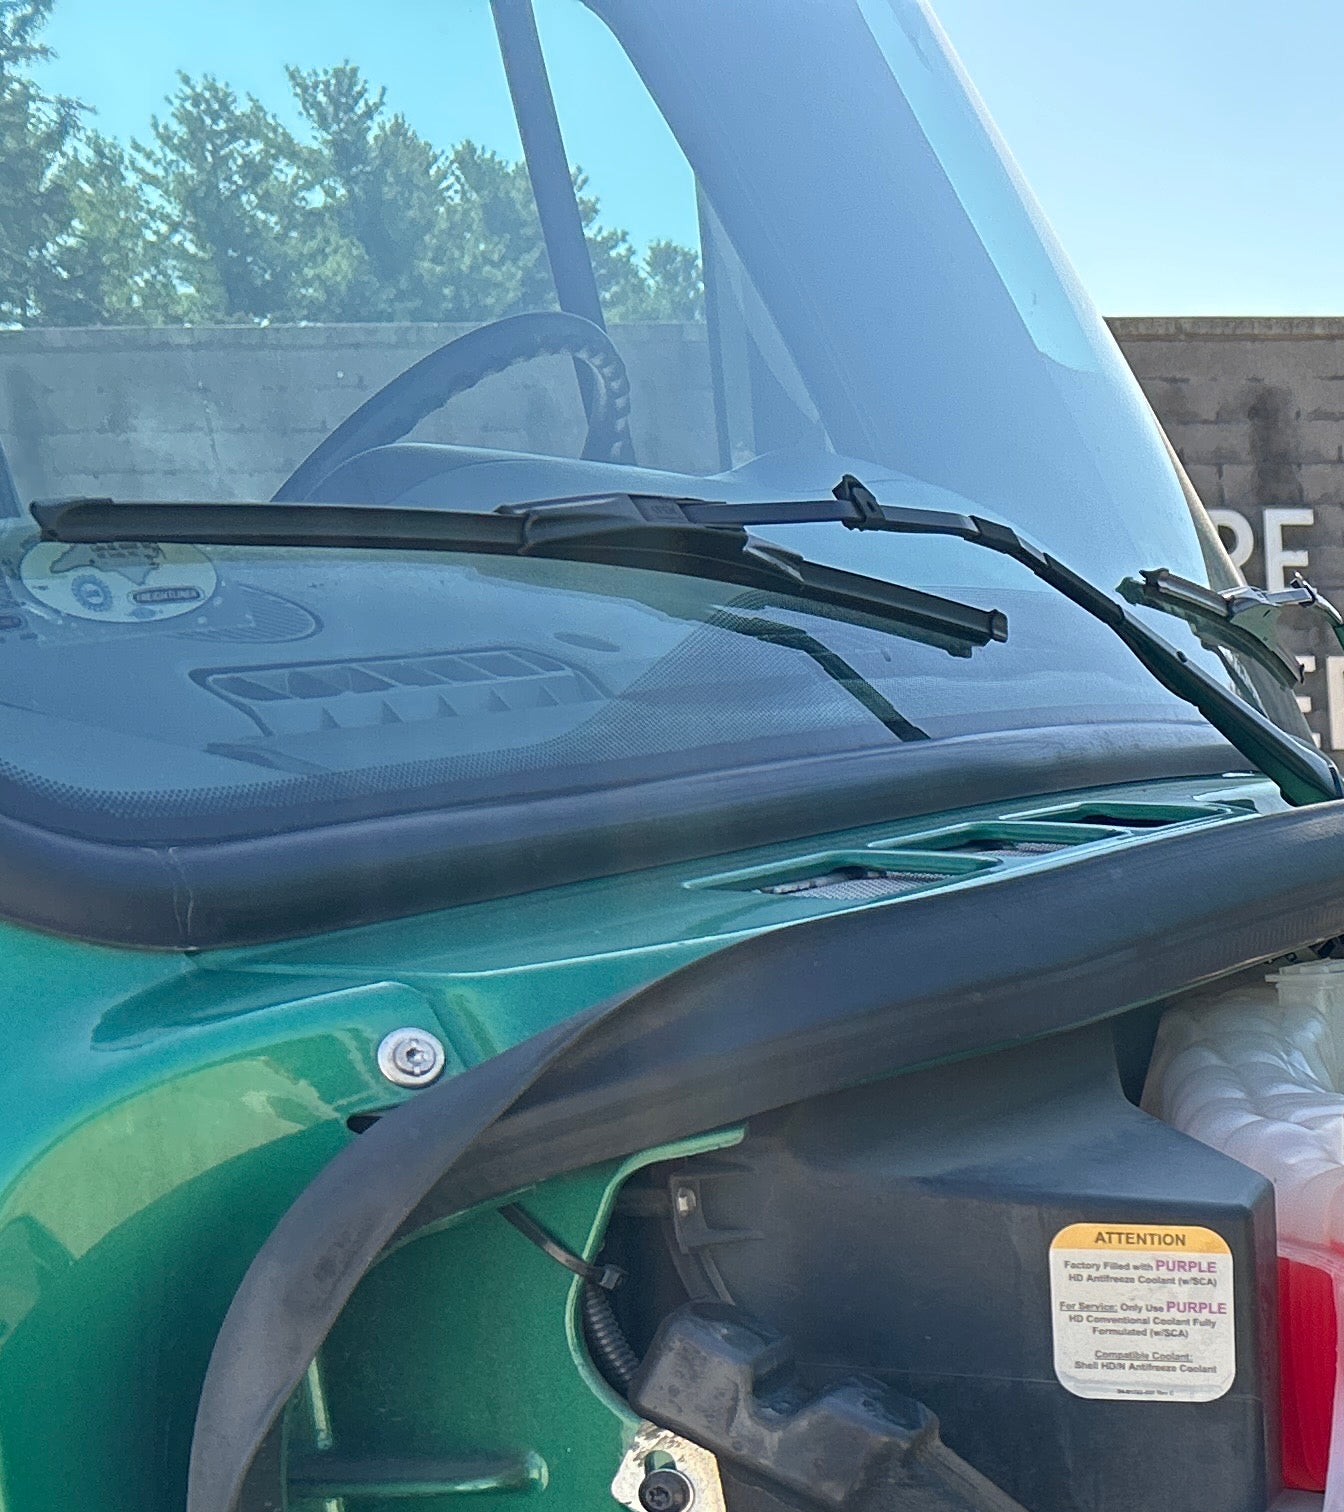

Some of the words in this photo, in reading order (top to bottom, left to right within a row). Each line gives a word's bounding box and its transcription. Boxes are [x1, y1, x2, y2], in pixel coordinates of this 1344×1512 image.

[1094, 1232, 1186, 1246] ATTENTION
[1064, 1261, 1100, 1270] Factory
[1104, 1262, 1130, 1270] Filled
[1133, 1263, 1153, 1271] with
[1155, 1260, 1217, 1273] PURPLE
[1087, 1275, 1135, 1283] Antifreeze
[1138, 1276, 1175, 1284] Coolant
[1060, 1302, 1076, 1311] For
[1120, 1304, 1142, 1313] Only
[1146, 1304, 1164, 1313] Use
[1167, 1302, 1227, 1314] PURPLE
[1069, 1315, 1083, 1323] HD
[1086, 1316, 1150, 1324] Conventional
[1153, 1317, 1190, 1326] Coolant
[1193, 1319, 1216, 1328] Fully
[1092, 1327, 1147, 1336] Formulated
[1095, 1351, 1149, 1361] Compatible
[1075, 1361, 1098, 1369] Shell
[1129, 1363, 1177, 1372] Antifreeze
[1180, 1364, 1217, 1373] Coolant
